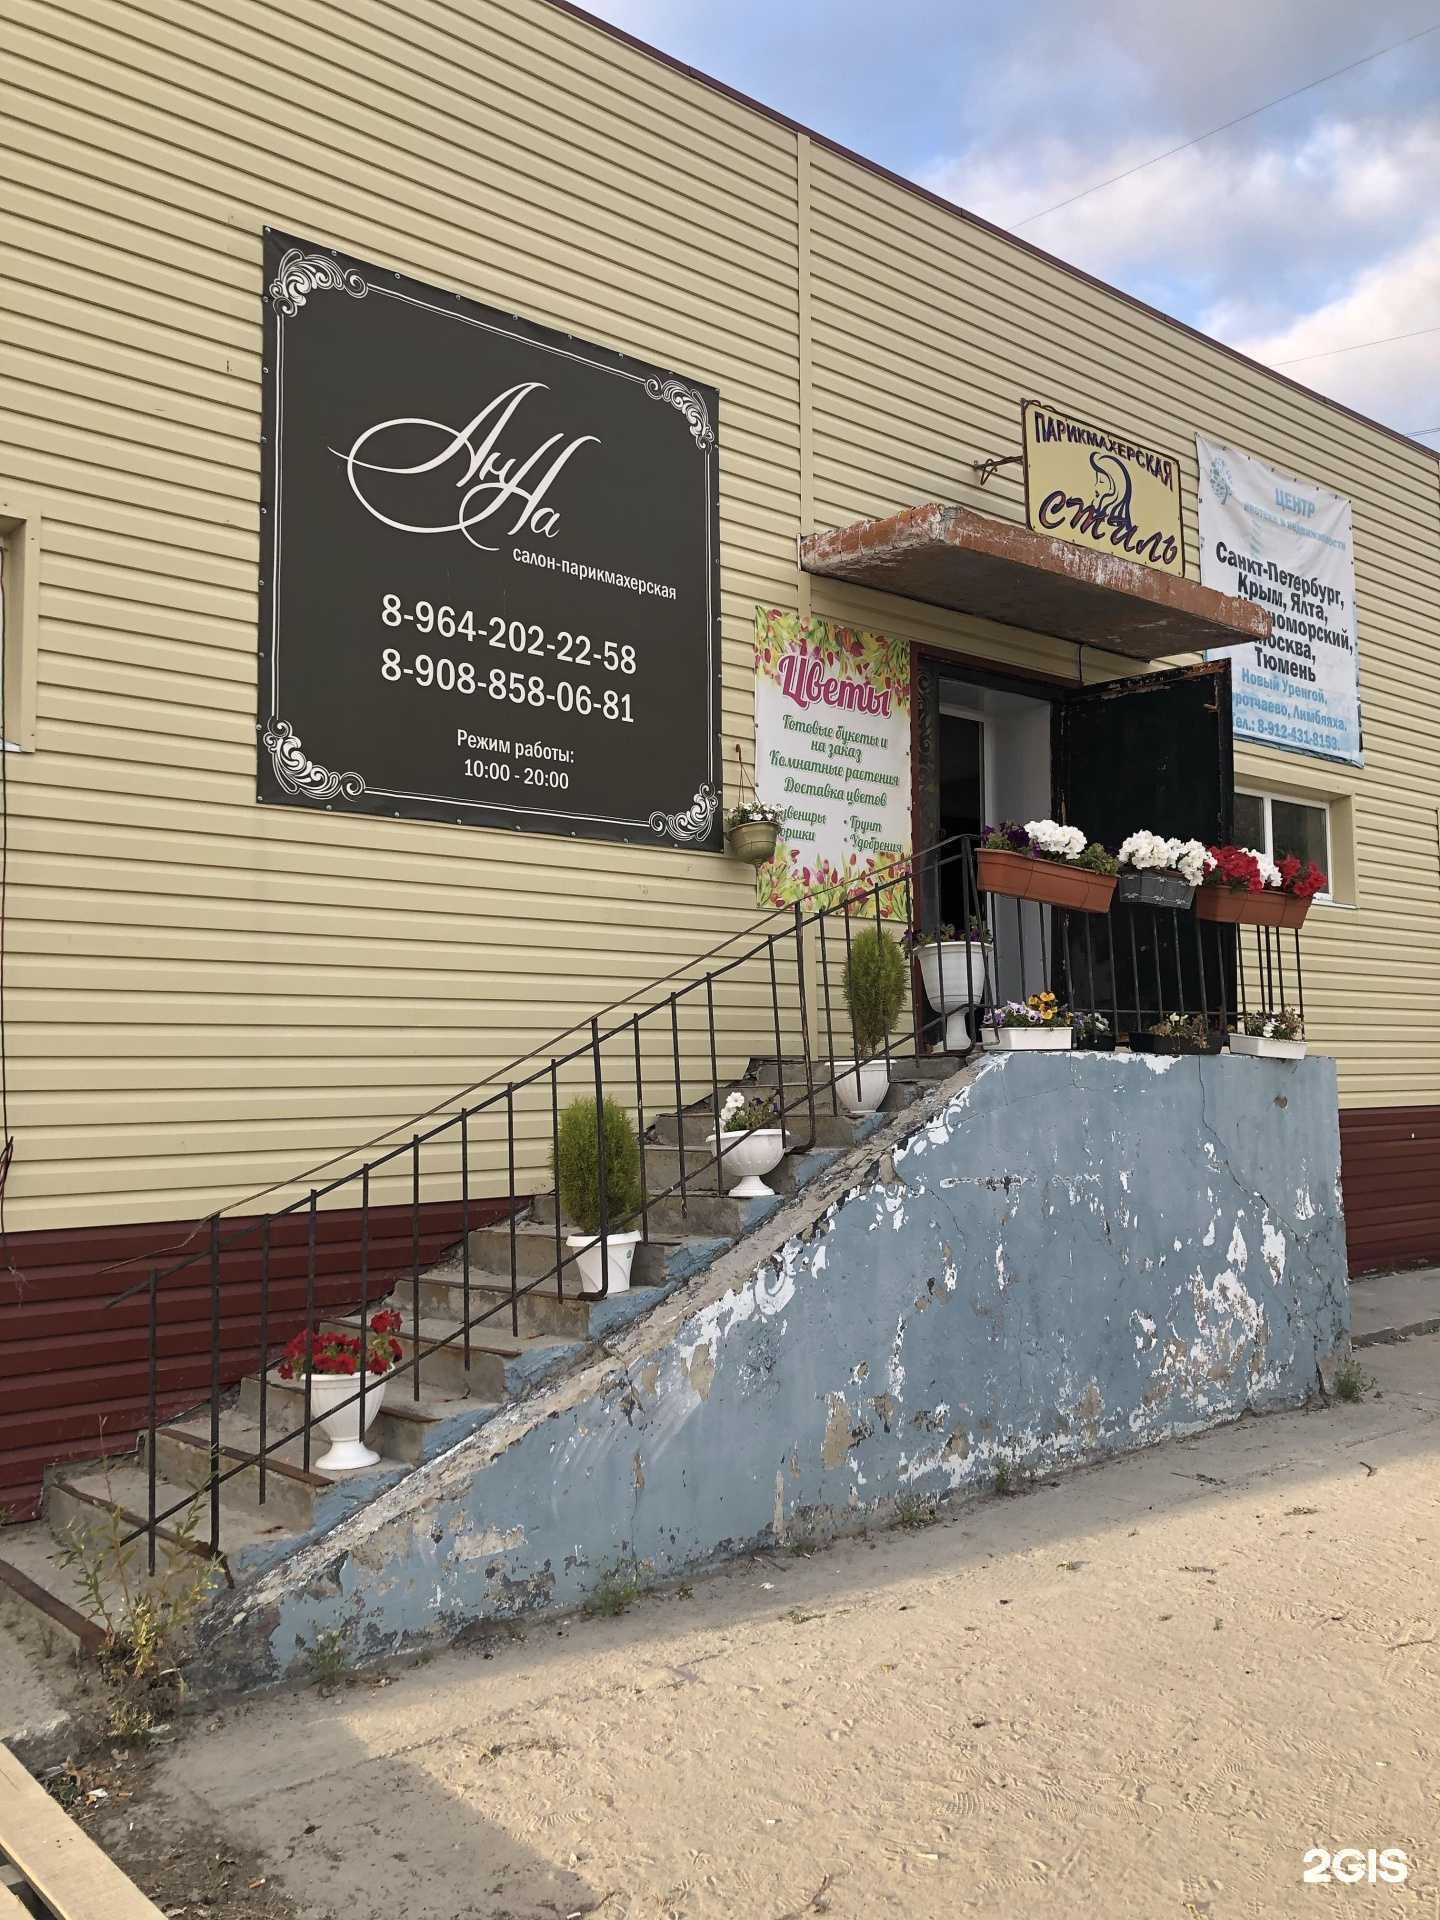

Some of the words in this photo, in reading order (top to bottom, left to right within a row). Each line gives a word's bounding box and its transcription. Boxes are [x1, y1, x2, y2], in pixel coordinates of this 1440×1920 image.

[1035, 411, 1173, 492] ПАРИКМАХЕРСКАЯ
[1275, 488, 1315, 518] ЦЕНТР
[513, 547, 677, 600] салон-парикмахерская
[1216, 541, 1344, 610] Санкт-Петербург,
[1237, 572, 1287, 613] Крым,
[1290, 593, 1328, 626] Ялта,
[381, 593, 637, 675] 8-964-202-22-58
[1256, 633, 1316, 665] осква,
[1264, 609, 1353, 656] номорский,
[1241, 667, 1280, 691] Новый
[1254, 646, 1317, 683] Тюмень
[381, 648, 634, 723] 8-908-858-06-81
[778, 655, 893, 719] Цветы
[783, 714, 834, 739] Готовые
[835, 724, 879, 750] букеты
[880, 735, 889, 748] и
[1232, 713, 1255, 732] ел.:
[457, 729, 511, 754] Режим
[514, 739, 575, 764] работы:
[810, 740, 826, 753] на
[827, 743, 863, 765] заказ
[464, 758, 510, 782] 10:00
[524, 767, 569, 790] 20:00
[769, 749, 844, 777] Комнатные
[845, 766, 899, 787] растения
[784, 776, 844, 800] Доставка
[846, 787, 888, 807] цветов
[777, 827, 816, 842] оршки
